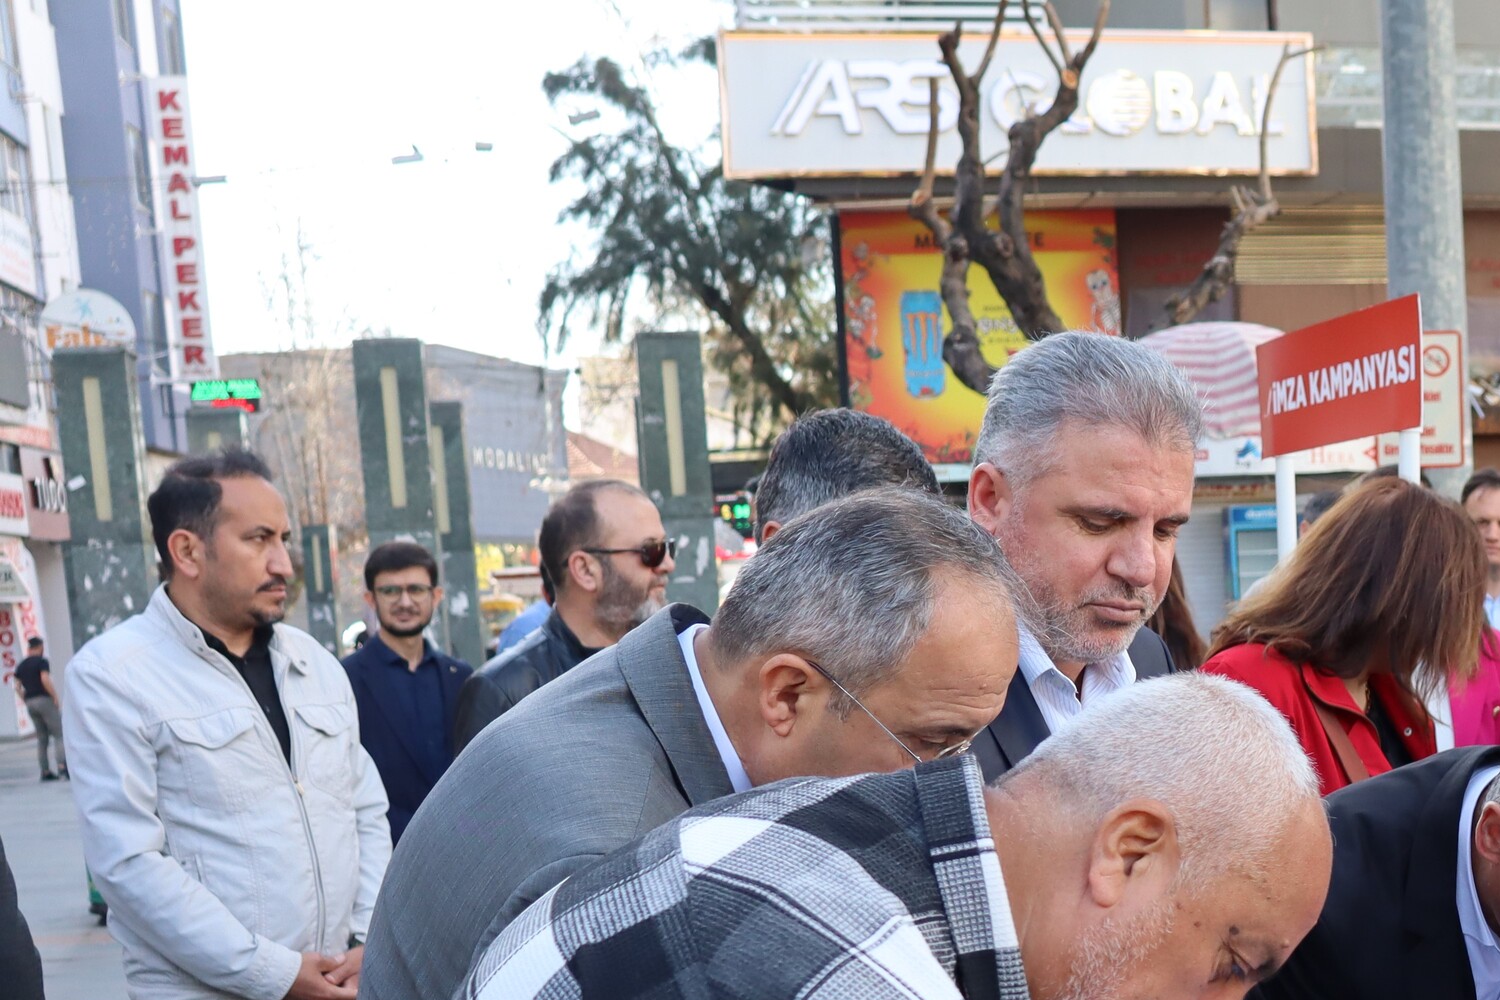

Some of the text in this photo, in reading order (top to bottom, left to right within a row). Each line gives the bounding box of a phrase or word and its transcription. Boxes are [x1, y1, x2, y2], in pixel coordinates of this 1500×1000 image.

[157, 89, 192, 222] KEMAL
[172, 236, 208, 367] PEKER
[1271, 344, 1416, 416] İMZA KAMPANYASI
